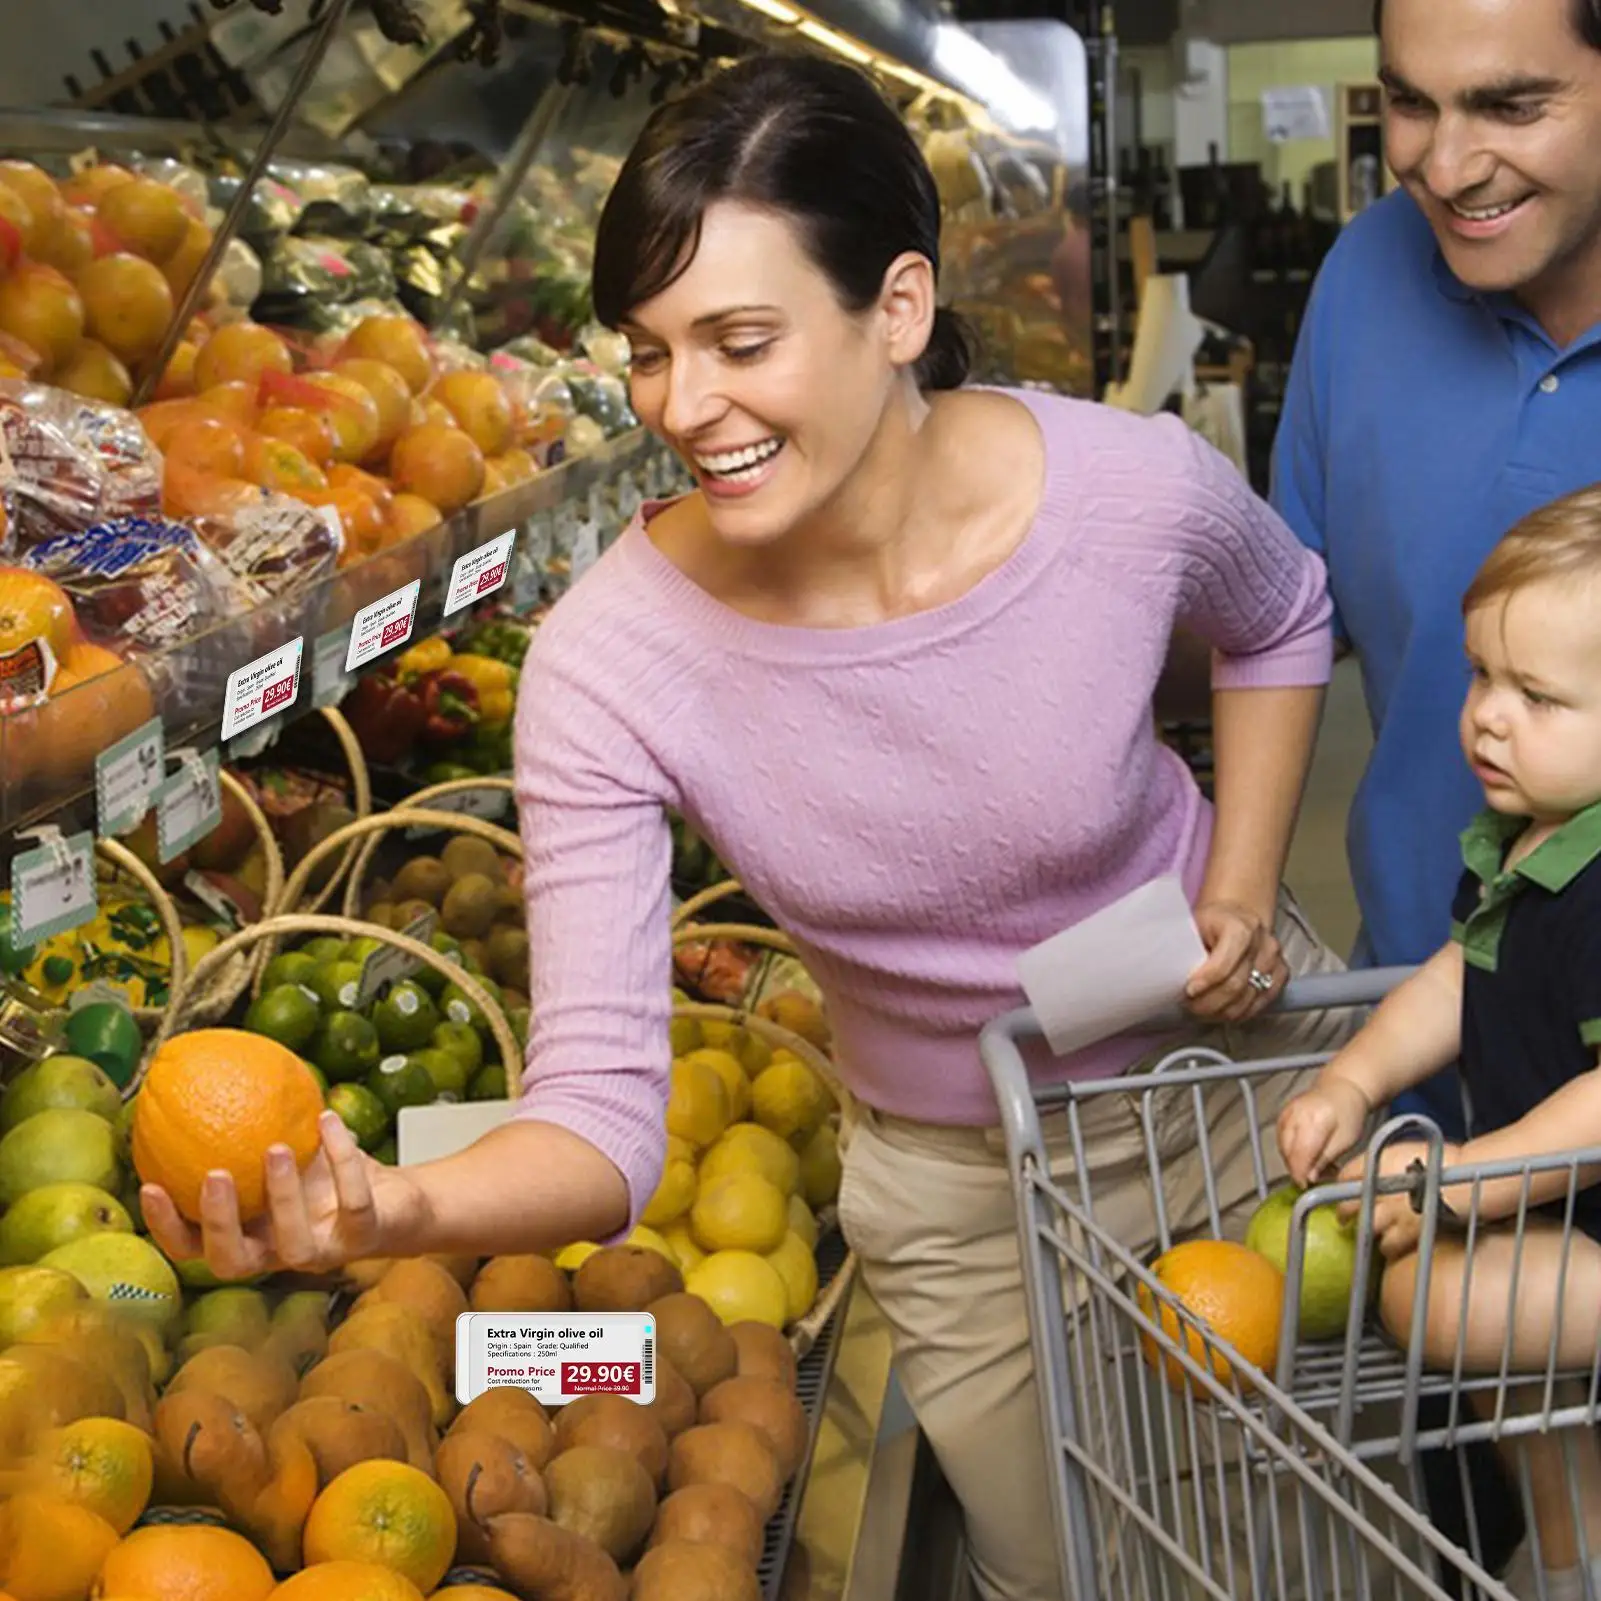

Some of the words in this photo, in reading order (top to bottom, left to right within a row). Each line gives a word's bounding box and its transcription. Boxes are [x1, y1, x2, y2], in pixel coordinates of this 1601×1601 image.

[237, 678, 250, 687] Extra
[251, 668, 264, 680] Virgin
[265, 663, 276, 673] olive
[265, 678, 291, 703] 29.90€
[235, 703, 250, 714] Promo
[251, 696, 261, 705] Price
[487, 1329, 516, 1338] Extra
[519, 1328, 554, 1341] Virgin
[558, 1328, 585, 1338] olive
[589, 1328, 603, 1338] oil
[487, 1367, 524, 1376] Promo
[529, 1367, 555, 1376] Price
[567, 1365, 635, 1383] 29.90€
